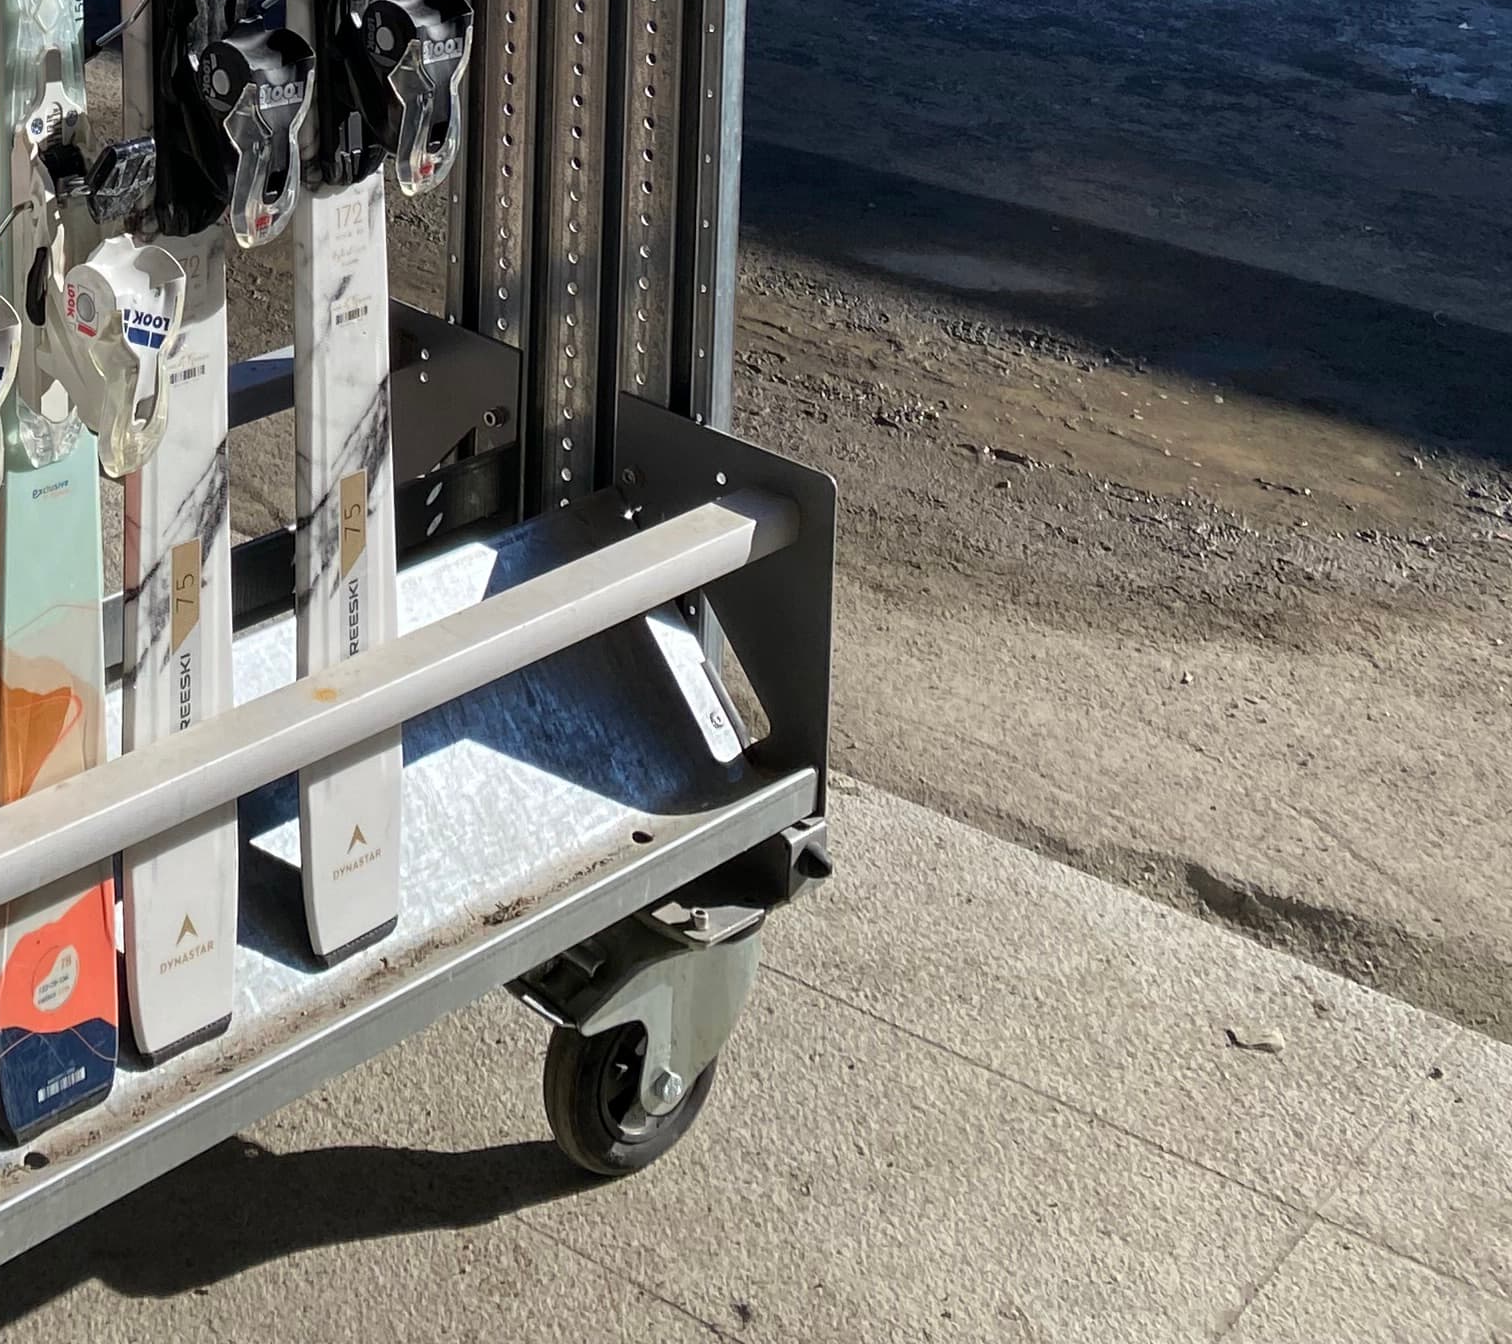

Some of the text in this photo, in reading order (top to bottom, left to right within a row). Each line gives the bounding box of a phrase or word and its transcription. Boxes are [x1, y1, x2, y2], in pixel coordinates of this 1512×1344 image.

[336, 202, 363, 229] 172
[67, 283, 76, 318] LOOK
[132, 309, 170, 332] LOOK
[32, 480, 69, 499] exclusive
[343, 501, 363, 537] 75
[175, 572, 197, 609] 75
[348, 576, 361, 658] REESKI
[178, 651, 192, 732] REESKI
[333, 847, 383, 881] DYNASTAR
[159, 939, 215, 975] DYNASTAR
